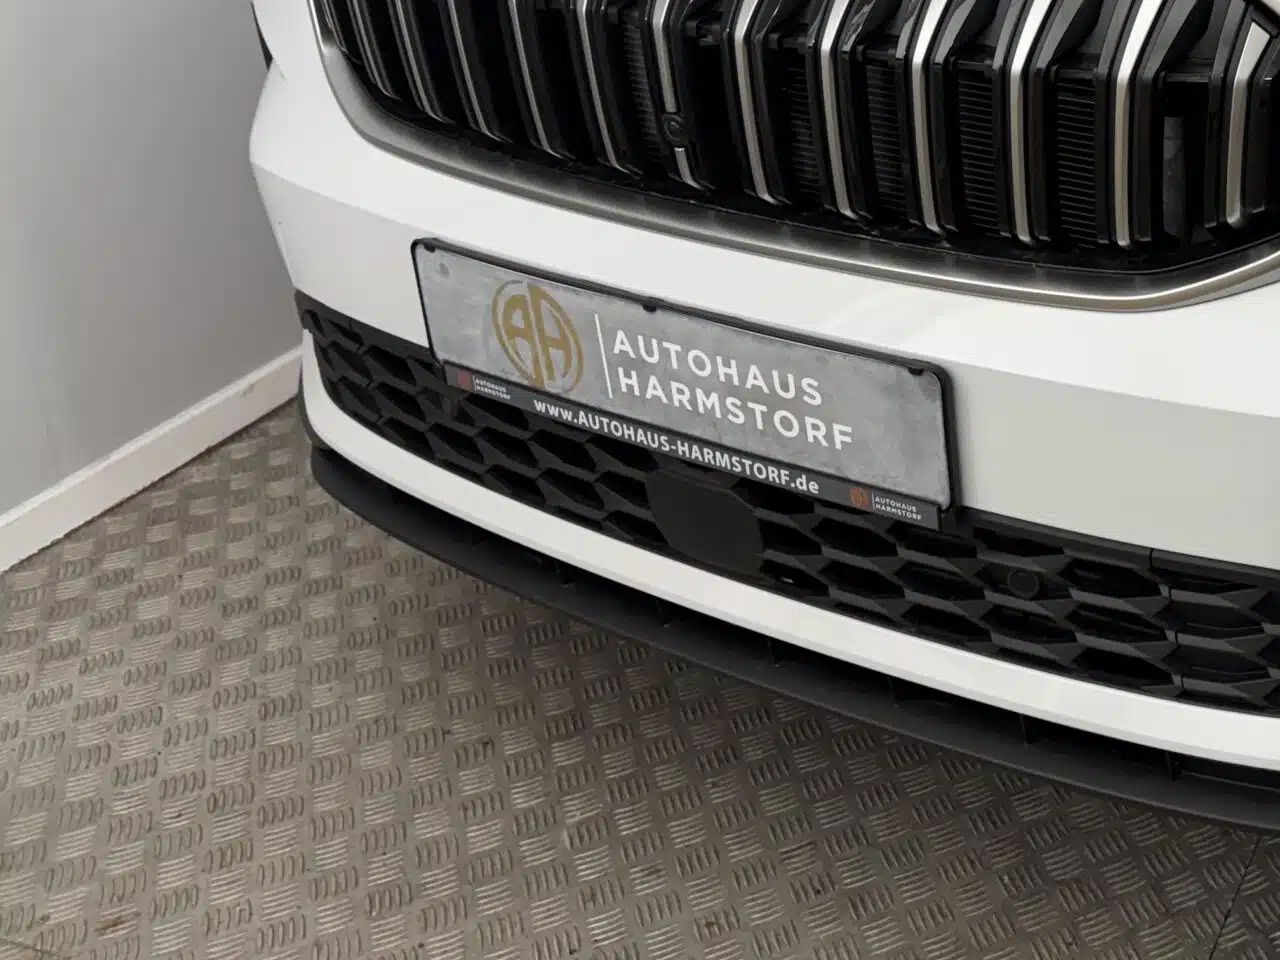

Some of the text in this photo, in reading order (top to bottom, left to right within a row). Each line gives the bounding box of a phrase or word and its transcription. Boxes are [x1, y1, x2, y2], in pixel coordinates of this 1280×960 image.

[613, 329, 823, 407] AUTOHAUS
[533, 399, 820, 494] www.AUTOHAUS-HARMSTORF.de
[617, 366, 854, 451] HARMSTORF
[874, 495, 917, 513] AUTOHAUS
[875, 503, 923, 521] HARMSTORF
